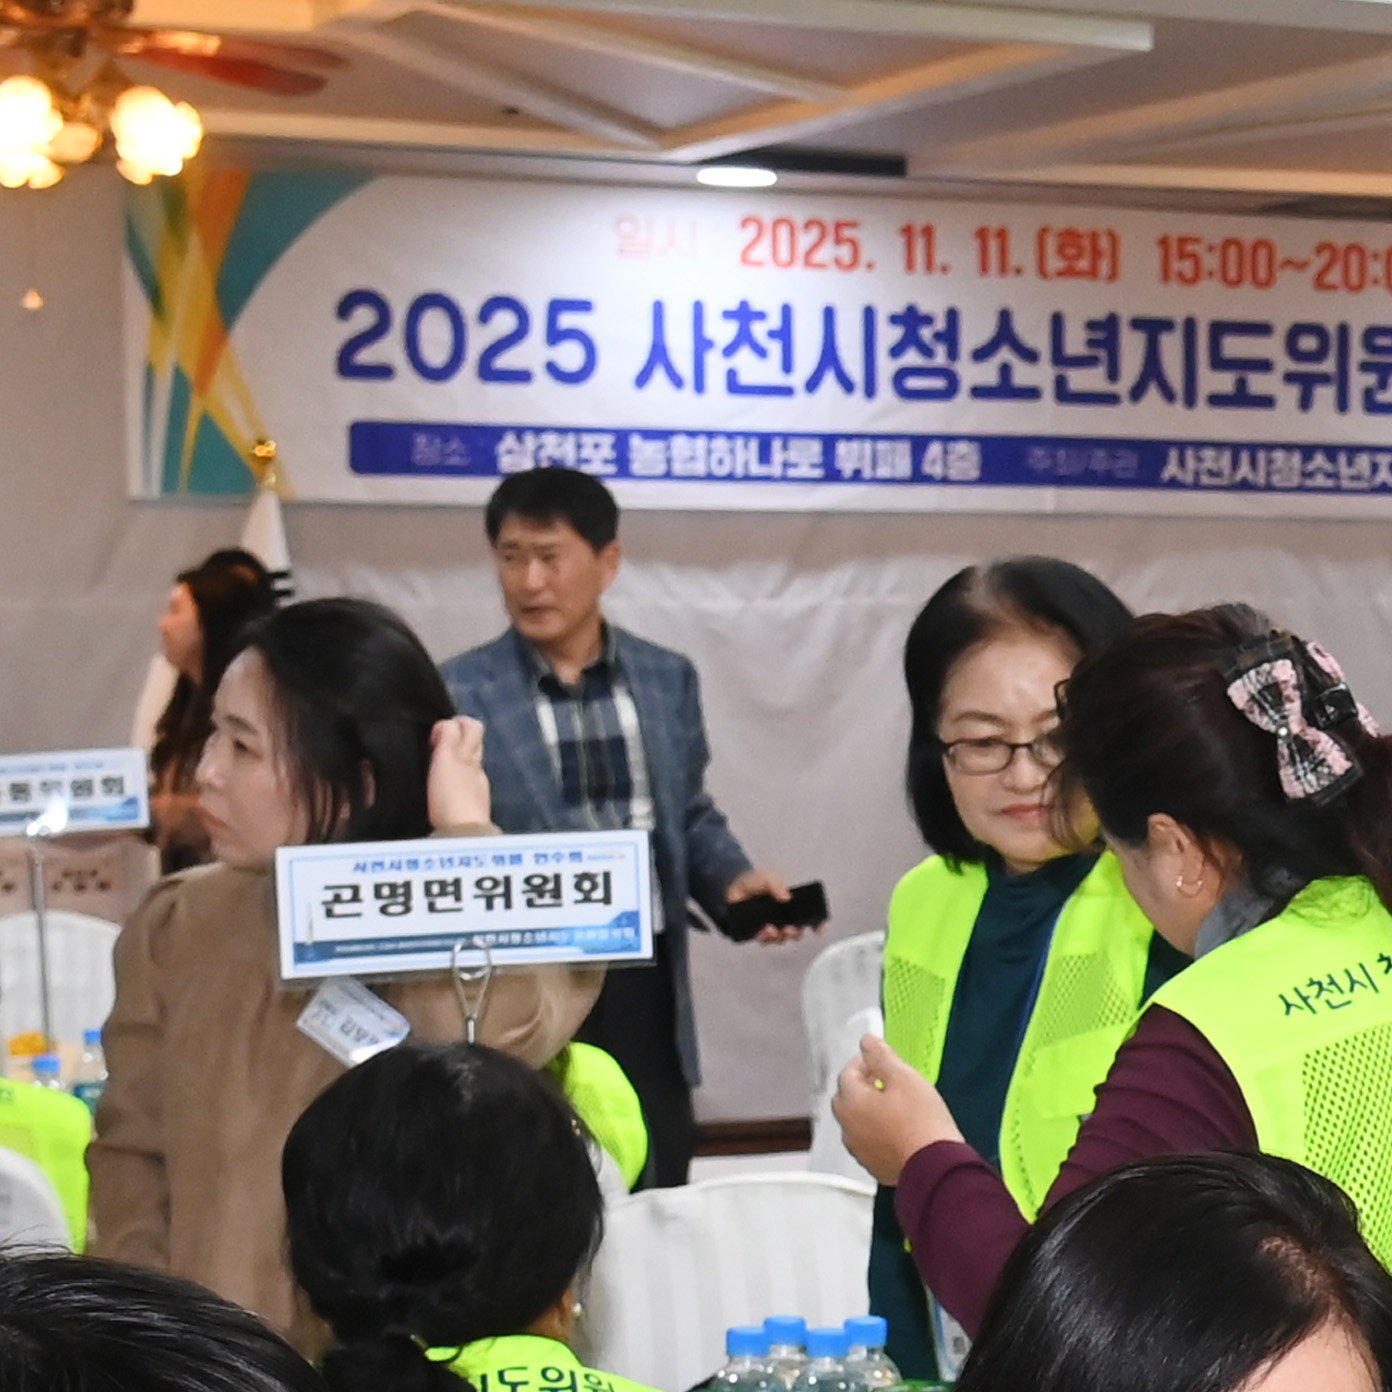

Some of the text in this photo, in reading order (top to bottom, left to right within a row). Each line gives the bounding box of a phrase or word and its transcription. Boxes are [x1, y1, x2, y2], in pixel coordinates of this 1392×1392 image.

[739, 216, 876, 272] 2025.
[900, 222, 951, 276] 11.
[335, 288, 599, 385] 2025
[321, 870, 613, 919] 곤명면위원회
[1277, 962, 1380, 1018] 사천시
